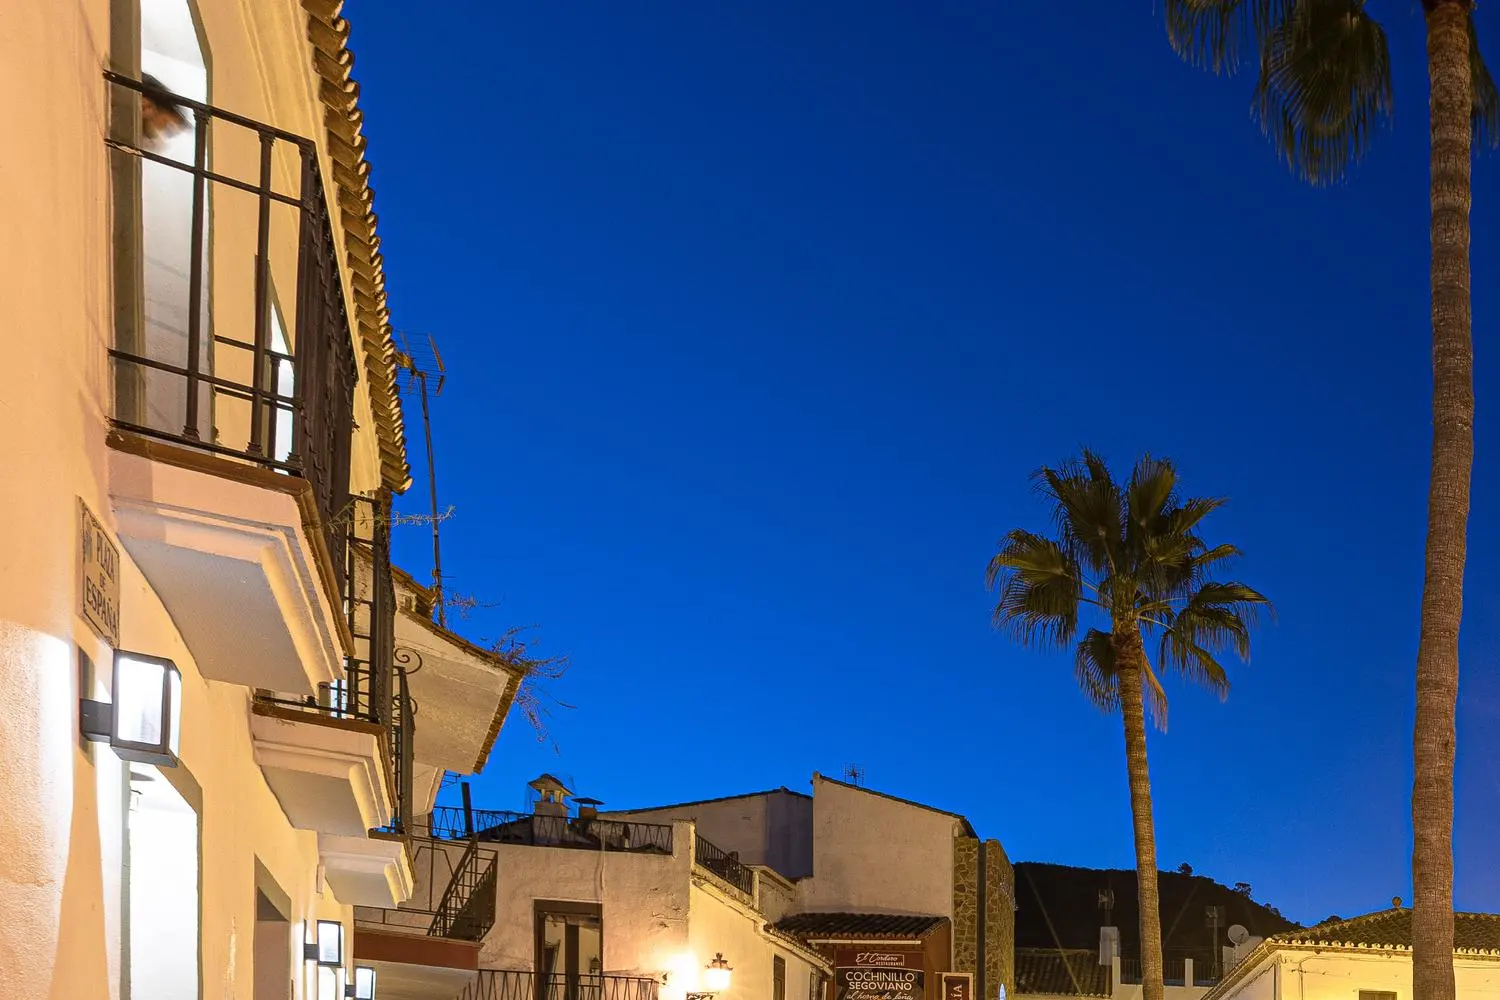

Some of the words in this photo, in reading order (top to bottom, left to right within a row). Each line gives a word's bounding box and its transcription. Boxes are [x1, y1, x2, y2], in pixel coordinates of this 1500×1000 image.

[96, 530, 115, 585] PLAZA
[100, 572, 106, 592] DE
[86, 575, 117, 639] ESPAÑA
[845, 971, 915, 982] COCHINILLO
[848, 981, 913, 991] SEGOVIANO
